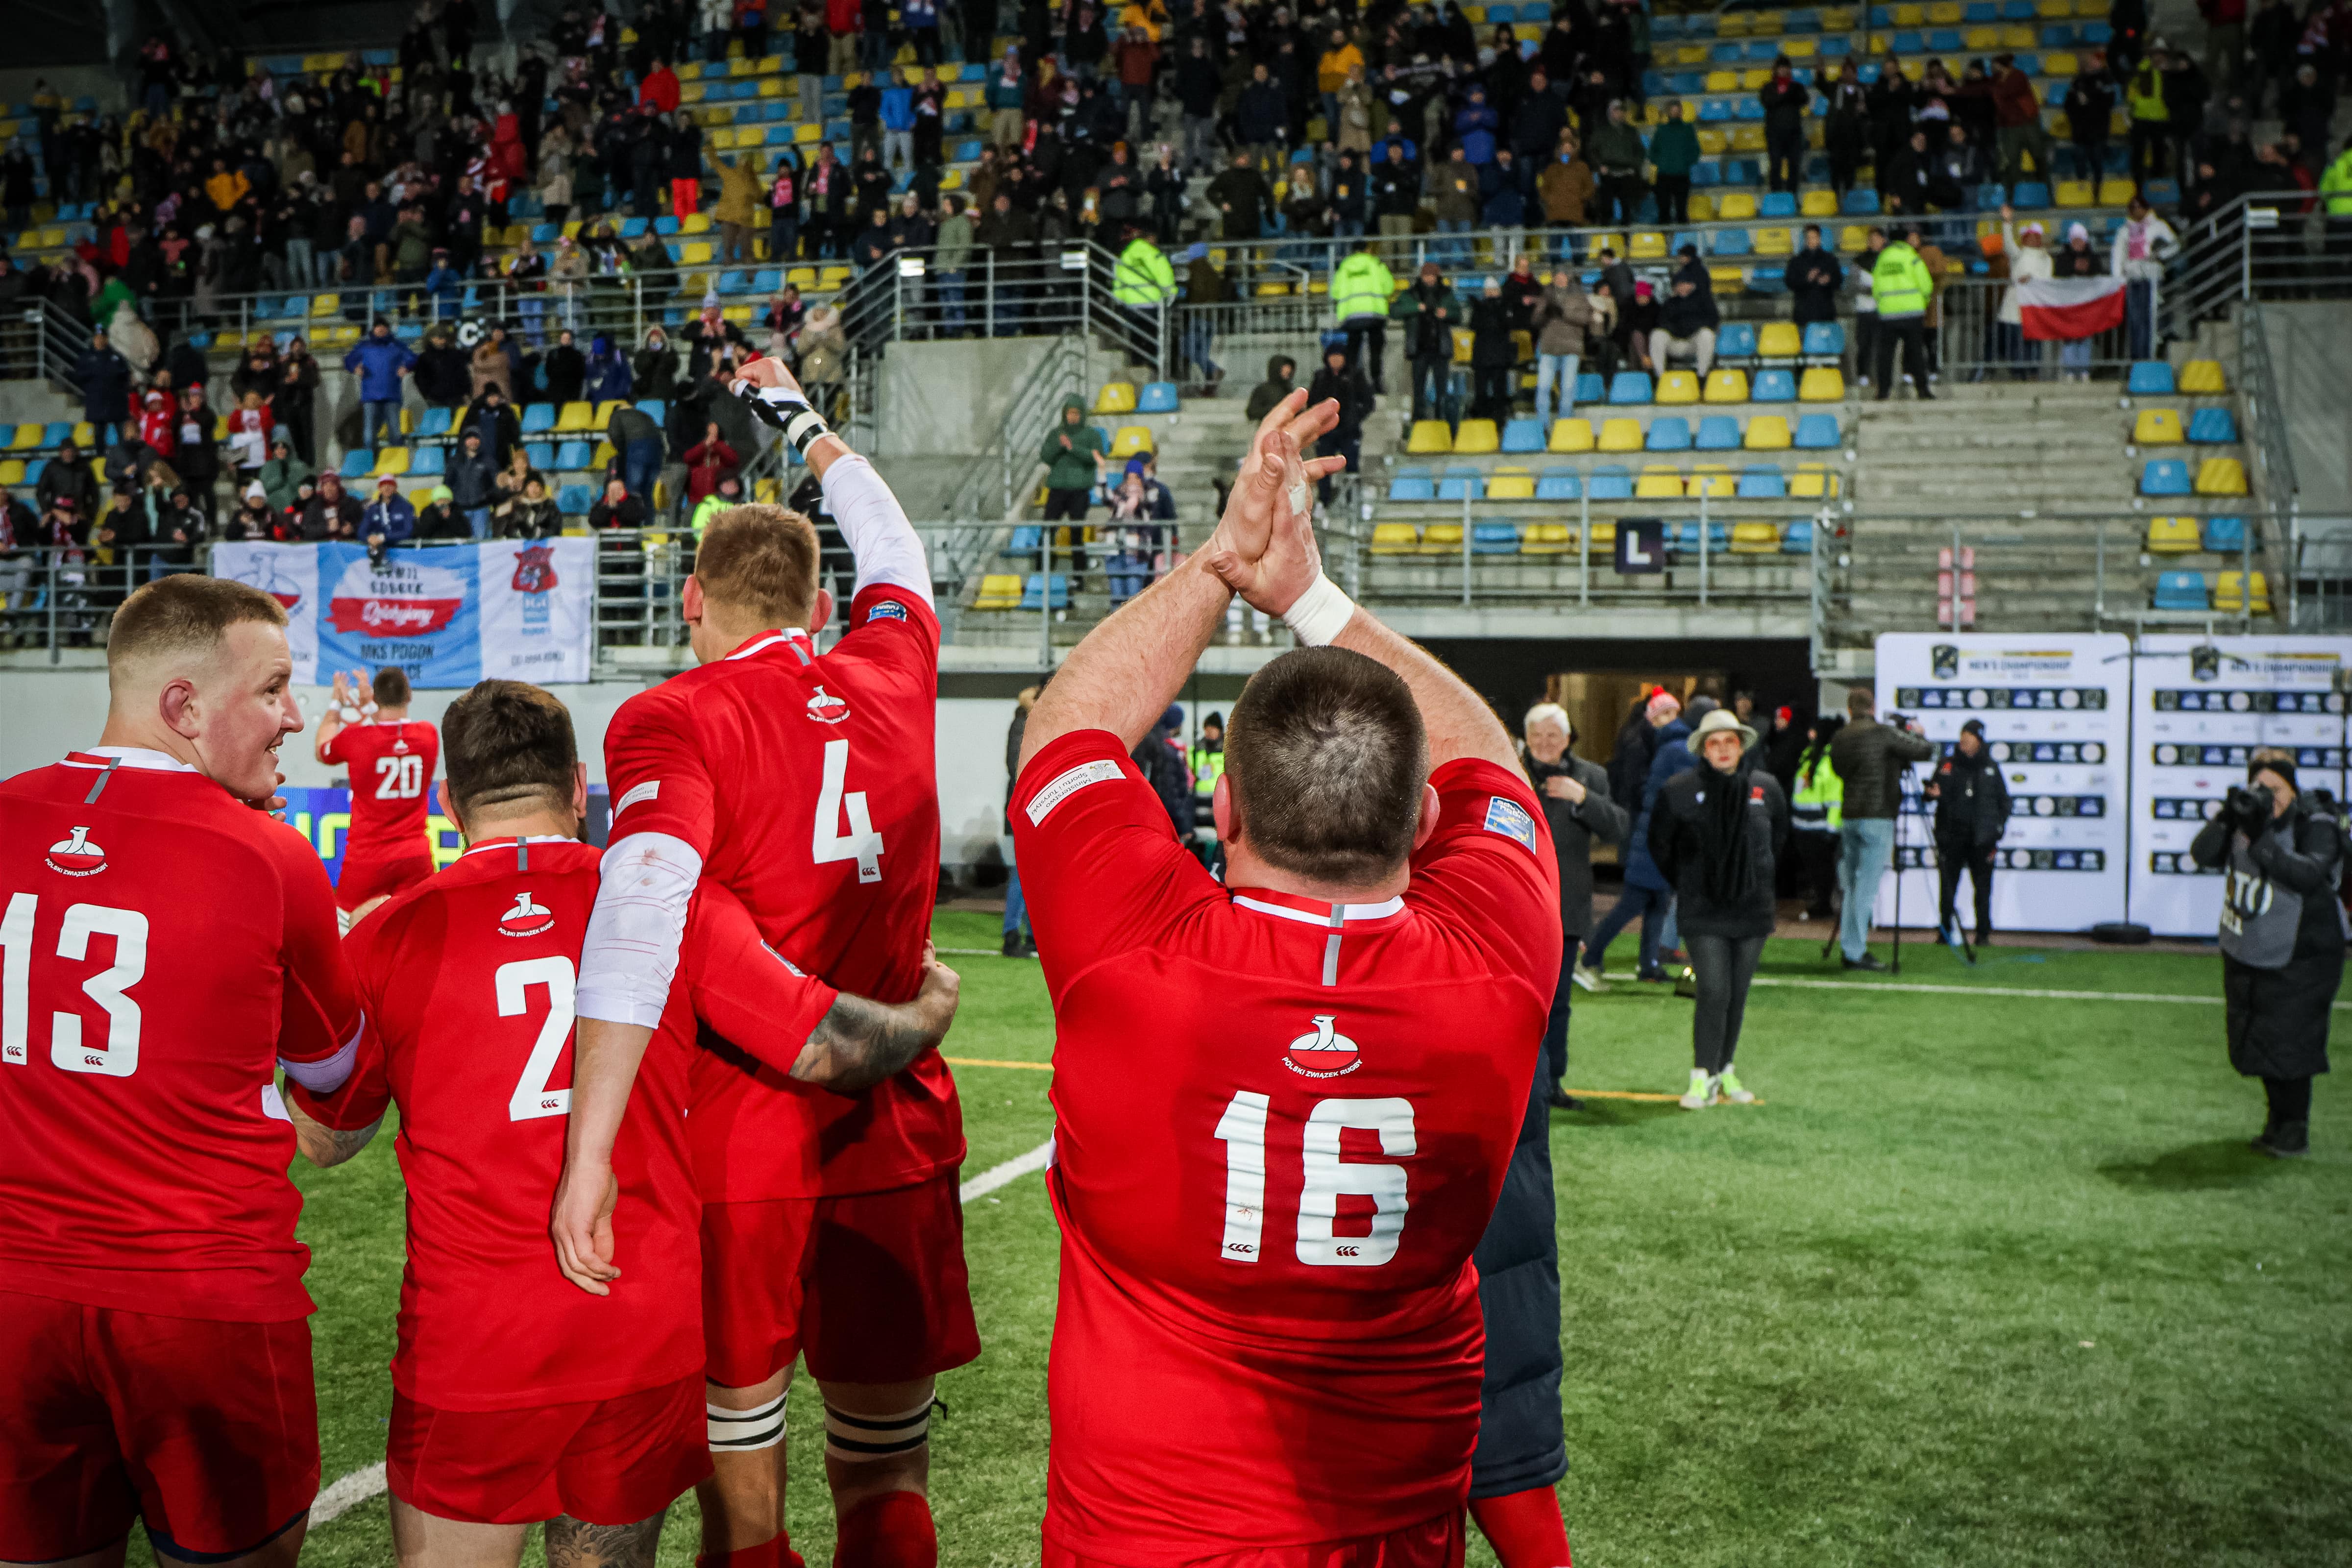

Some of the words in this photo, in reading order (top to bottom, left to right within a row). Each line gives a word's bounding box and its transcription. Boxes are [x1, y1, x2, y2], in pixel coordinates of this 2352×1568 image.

[1626, 529, 1652, 564] L
[375, 755, 423, 799] 20
[1046, 778, 1092, 808] Ministerstwo
[1062, 772, 1088, 785] Sportu
[813, 739, 884, 884] 4
[1031, 788, 1059, 816] Turystyki
[45, 858, 63, 873] POLSKI
[90, 862, 109, 875] RUGBY
[498, 927, 516, 937] POLSKI
[516, 929, 540, 937] ZWIĄZEK
[540, 919, 556, 932] RUGBY
[0, 892, 148, 1077] 13
[495, 956, 577, 1122] 2
[1281, 1056, 1306, 1076] POLSKI
[1305, 1071, 1339, 1079] ZWIĄZEK
[1340, 1058, 1363, 1075] RUGBY
[1214, 1090, 1417, 1266] 16
